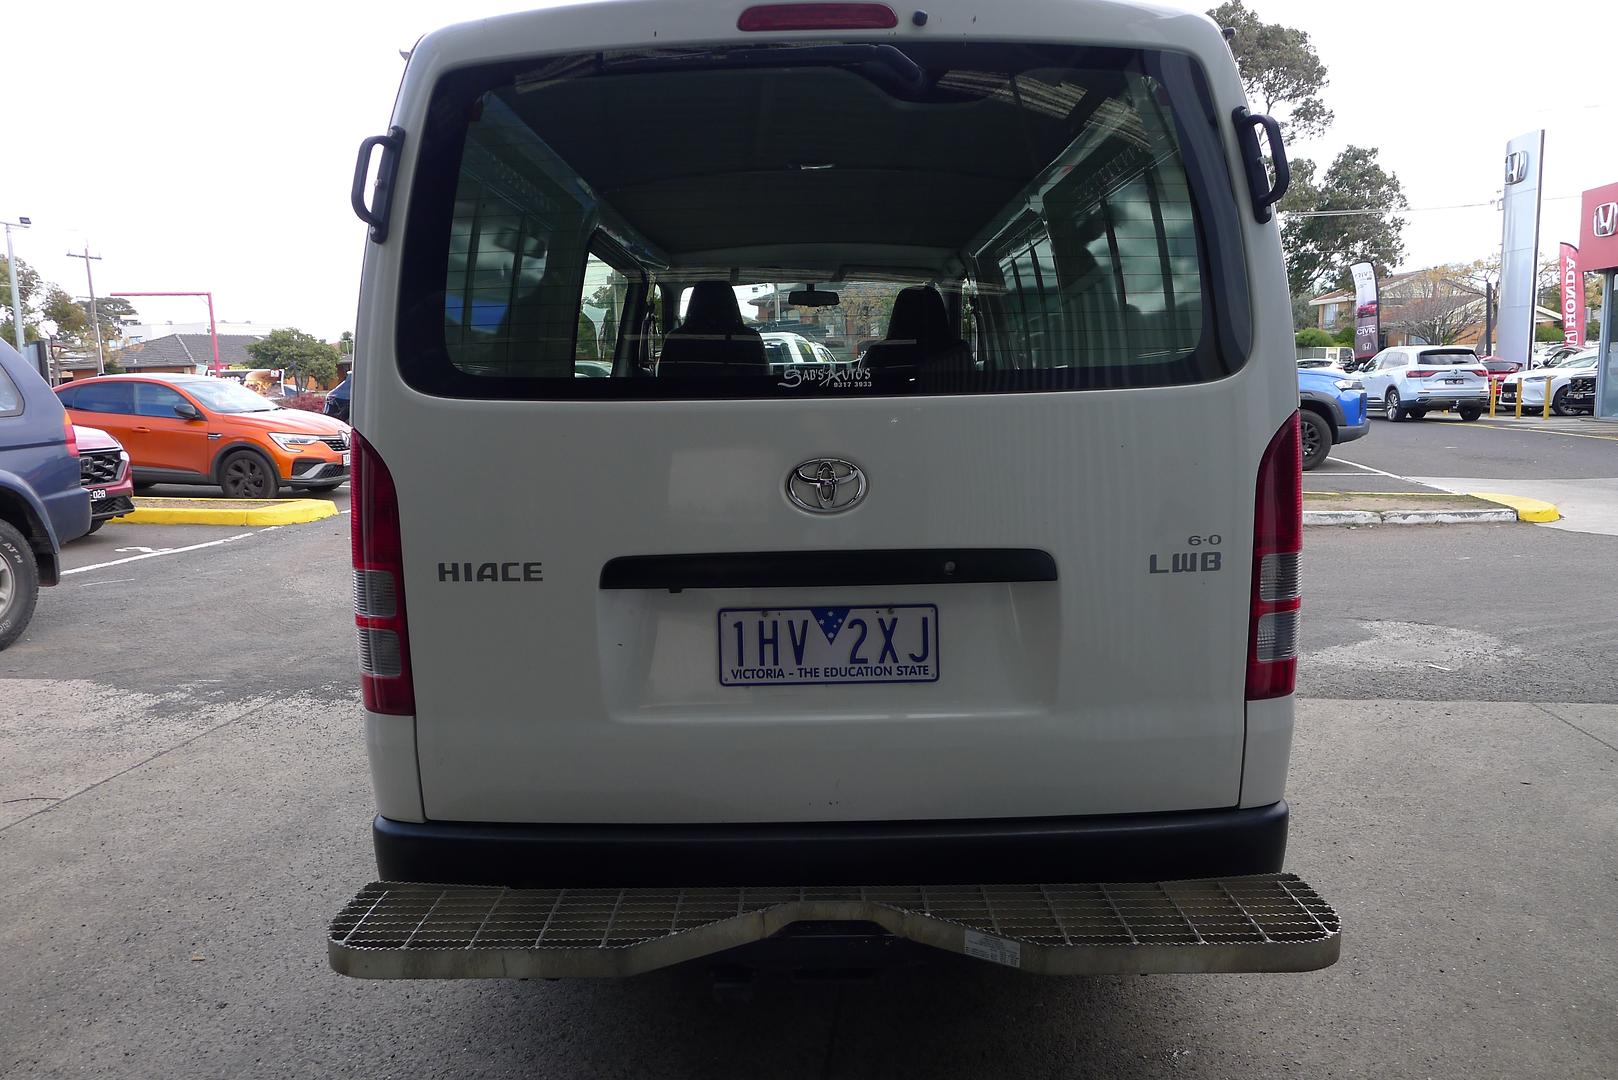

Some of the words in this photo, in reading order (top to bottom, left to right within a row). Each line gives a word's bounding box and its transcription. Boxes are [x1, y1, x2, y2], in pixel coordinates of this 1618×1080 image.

[1356, 327, 1376, 335] CIVIC
[438, 562, 544, 582] HIACE
[1149, 551, 1222, 574] LWB
[733, 619, 809, 668] 1HV
[847, 616, 929, 665] 2XJ
[731, 668, 785, 680] VICTORIA
[797, 667, 820, 679] THE
[823, 666, 893, 678] EDUCATION
[896, 665, 929, 676] STATE
